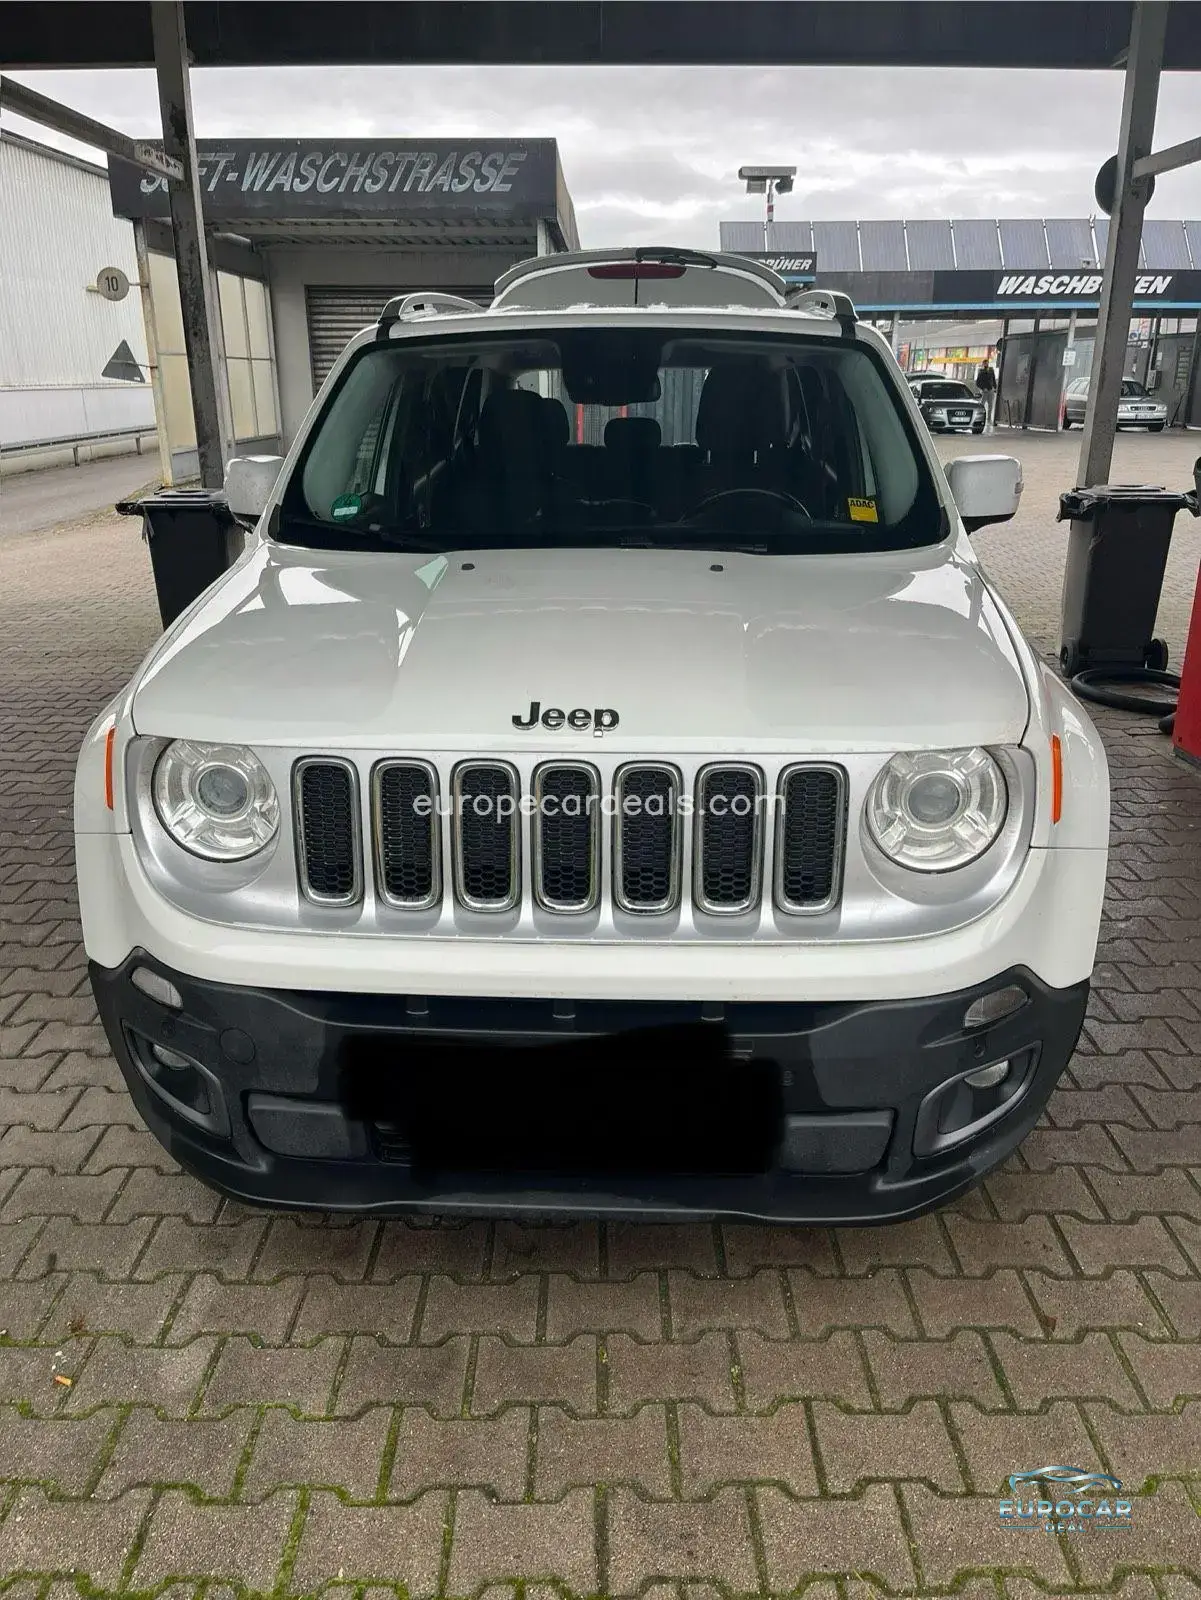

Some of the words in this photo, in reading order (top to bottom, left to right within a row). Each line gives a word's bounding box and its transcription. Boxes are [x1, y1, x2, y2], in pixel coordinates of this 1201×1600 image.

[105, 276, 119, 292] 10
[997, 275, 1172, 295] WASCHBEN
[850, 499, 875, 509] ADAC
[511, 701, 620, 738] Jeep
